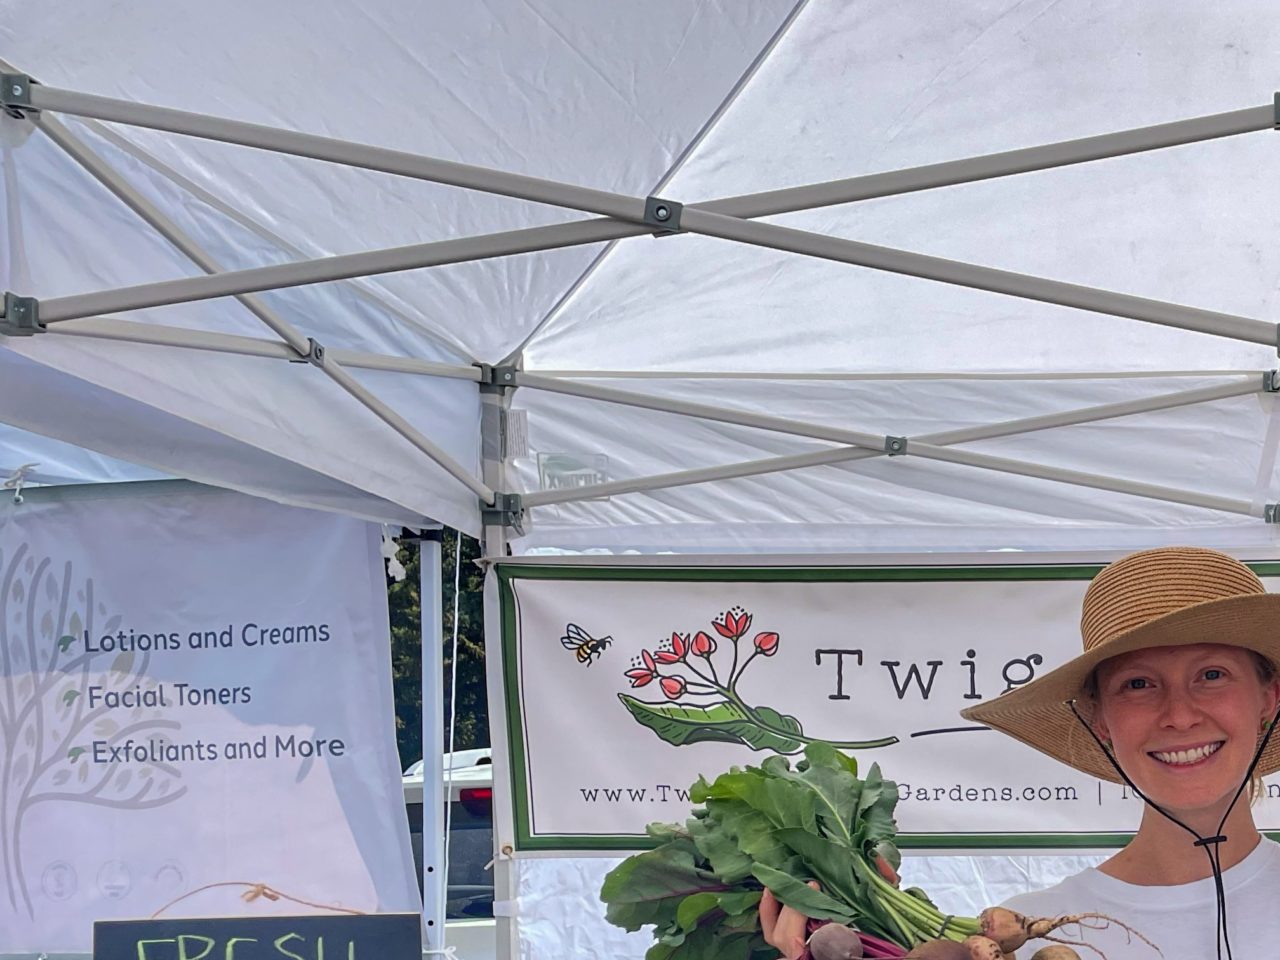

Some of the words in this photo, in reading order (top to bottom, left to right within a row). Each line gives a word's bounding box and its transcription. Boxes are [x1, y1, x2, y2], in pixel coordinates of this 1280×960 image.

[84, 627, 181, 653] Lotions
[188, 625, 234, 648] and
[242, 621, 330, 647] Creams
[815, 649, 1043, 700] Twig
[88, 684, 166, 708] Facial
[173, 683, 252, 707] Toners
[92, 739, 218, 764] Exfoliants
[224, 735, 267, 760] and
[275, 735, 345, 759] More
